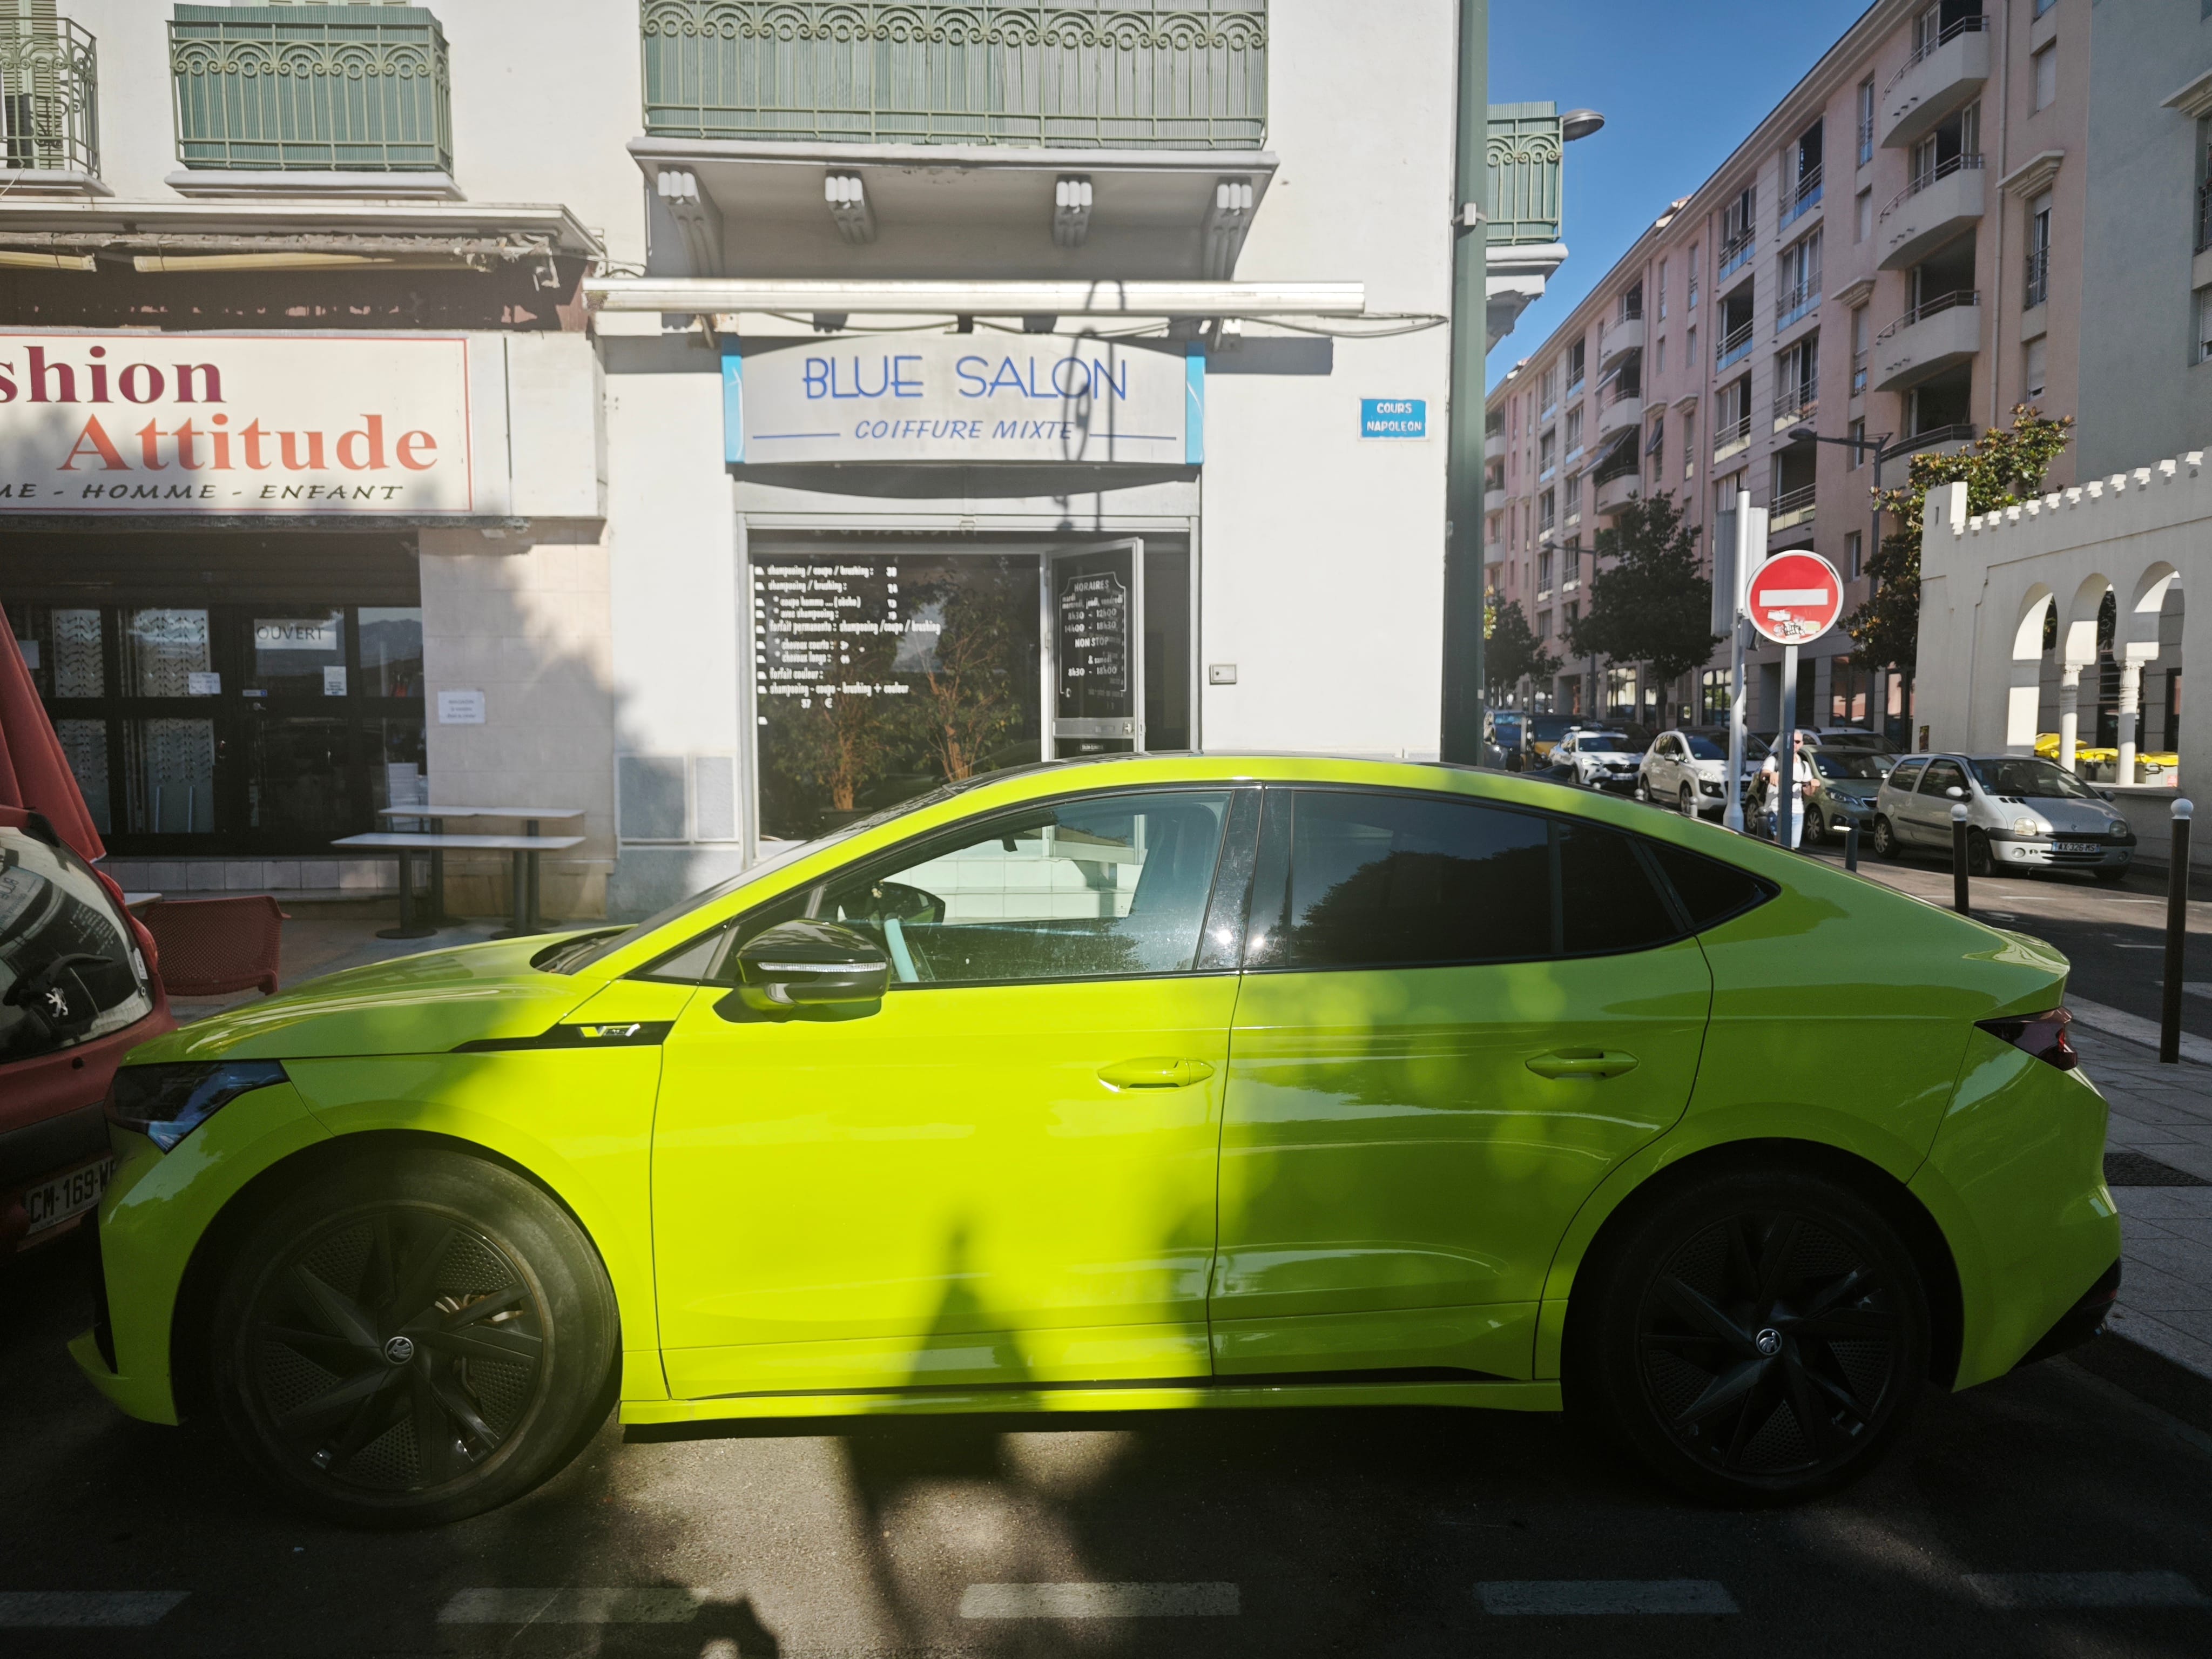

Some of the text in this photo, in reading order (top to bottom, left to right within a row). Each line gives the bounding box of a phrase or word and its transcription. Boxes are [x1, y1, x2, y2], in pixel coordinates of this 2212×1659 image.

[802, 355, 1125, 401] BLUE SALON
[1377, 402, 1412, 414] COURS
[854, 420, 1075, 441] COIFFURE MIXTE
[1367, 421, 1422, 432] NAPOLEON
[56, 413, 438, 470] Attitude
[82, 483, 217, 500] HOMME
[259, 484, 404, 500] ENFANT
[1074, 579, 1110, 592] HORAIRES
[257, 626, 323, 640] OUVERT
